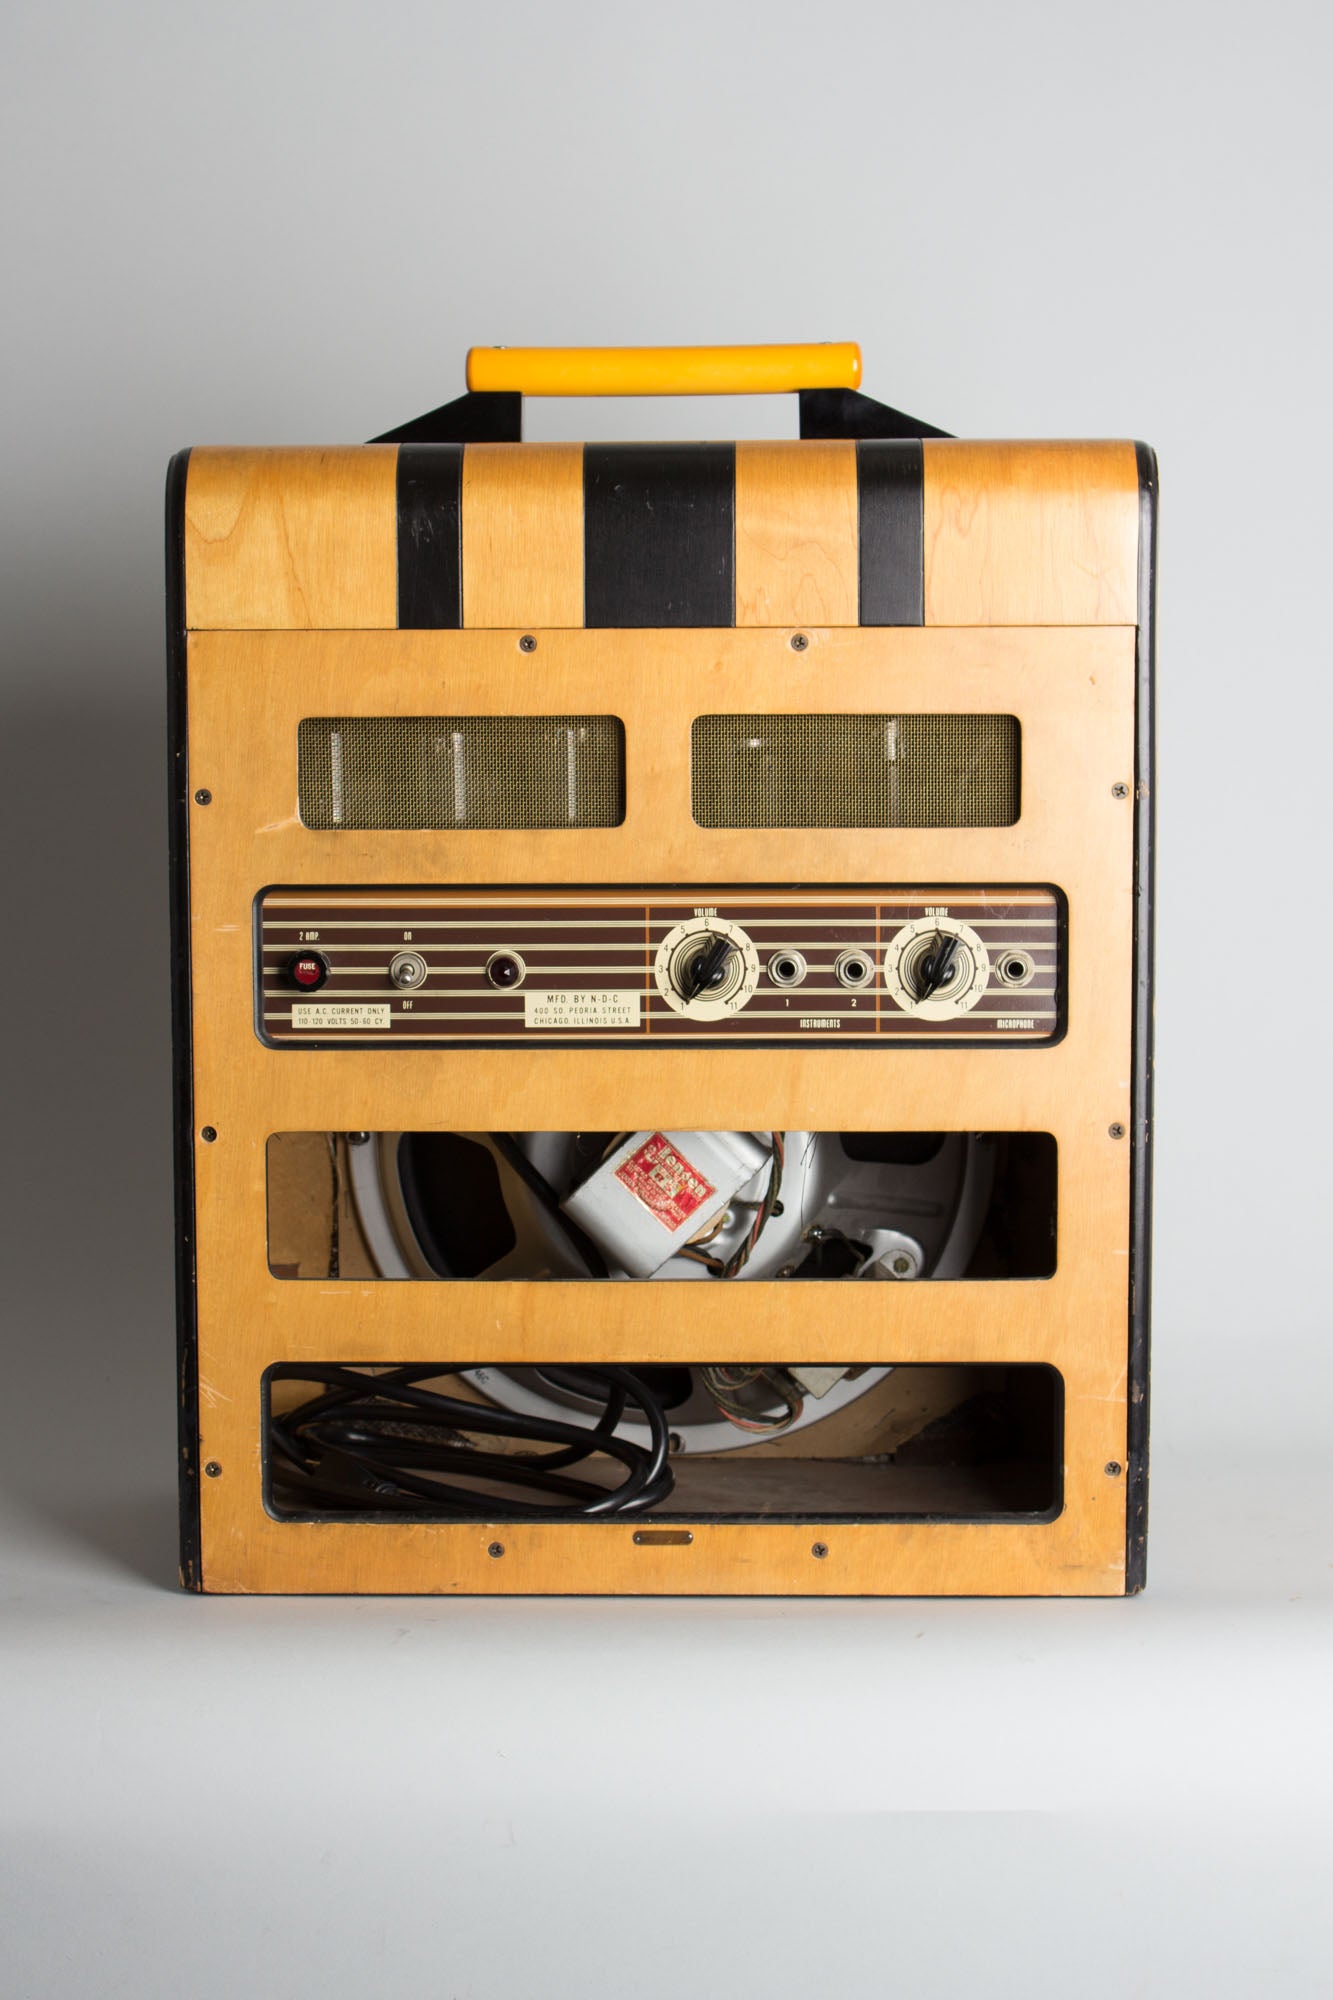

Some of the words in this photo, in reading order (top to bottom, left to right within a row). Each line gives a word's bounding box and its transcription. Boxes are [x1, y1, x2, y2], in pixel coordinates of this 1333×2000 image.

[694, 907, 718, 917] VOLUME
[925, 907, 949, 917] VOLUME
[704, 918, 710, 927] 6
[934, 918, 940, 926] 6
[680, 925, 686, 934] 5
[728, 924, 734, 934] 7
[909, 924, 915, 933] 5
[959, 924, 965, 933] 7
[299, 931, 304, 941] 2
[403, 931, 412, 941] ON
[663, 944, 669, 952] 4
[745, 943, 751, 951] 8
[894, 943, 900, 952] 4
[976, 943, 982, 952] 8
[299, 962, 316, 970] FUSE
[658, 965, 664, 974] 3
[750, 964, 756, 973] 9
[887, 964, 893, 973] 3
[980, 965, 986, 973] 9
[664, 987, 669, 997] 2
[744, 984, 753, 994] 10
[894, 986, 900, 996] 2
[974, 984, 984, 993] 10
[573, 994, 586, 1004] BY
[785, 998, 790, 1008] 1
[851, 998, 857, 1008] 2
[402, 1000, 414, 1010] OFF
[680, 1002, 685, 1011] 1
[729, 1002, 738, 1011] 11
[960, 1001, 969, 1010] 11
[297, 1007, 312, 1015] USE
[331, 1007, 363, 1015] CURRENT
[367, 1007, 385, 1015] ONLY
[602, 1006, 631, 1014] STREET
[327, 1017, 347, 1025] VOLTS
[573, 1017, 608, 1025] ILLINOIS
[799, 1018, 841, 1029] INSTRUMENTS
[996, 1018, 1034, 1029] MICROPHONE
